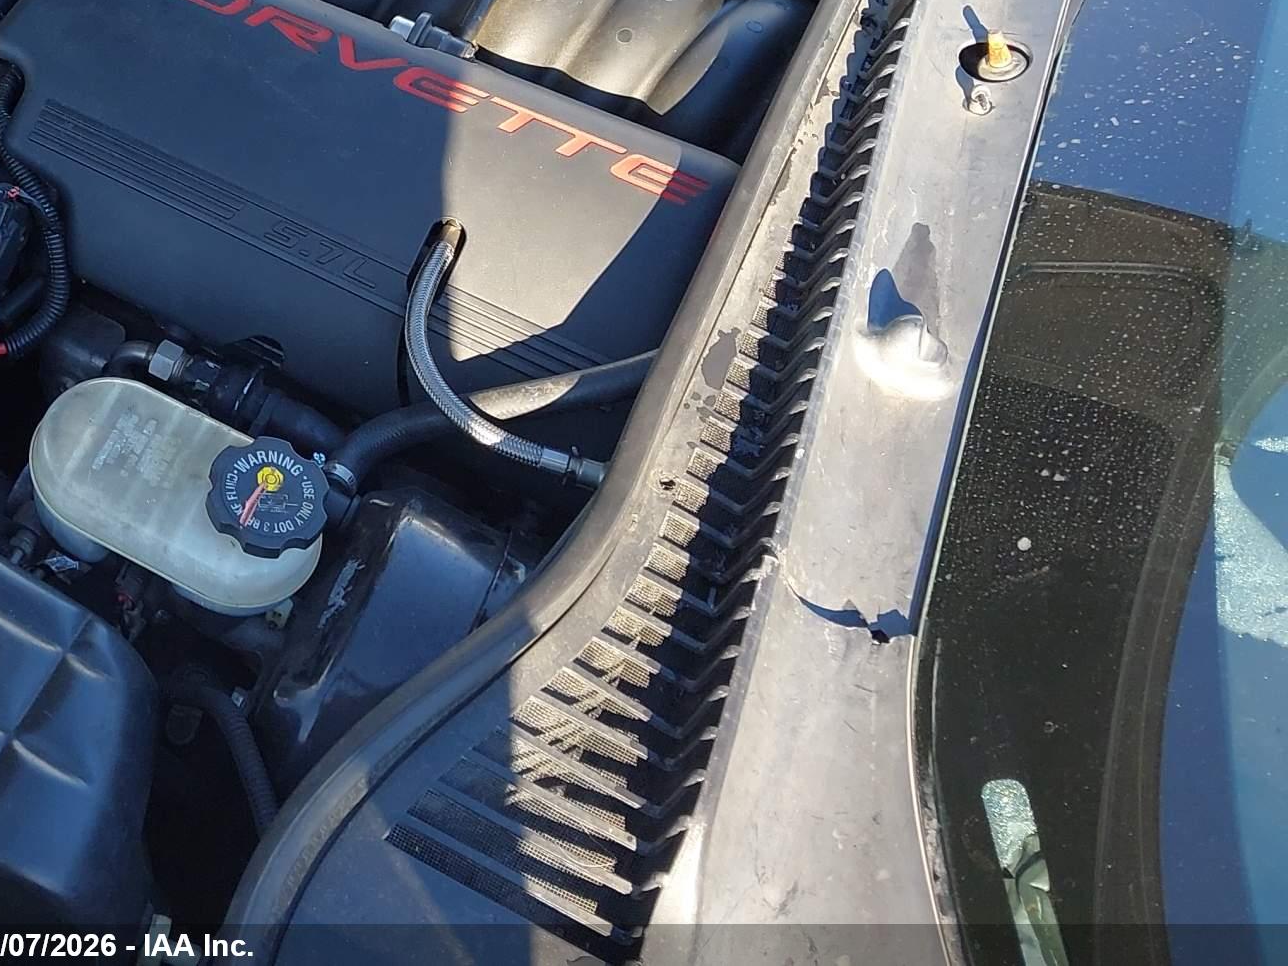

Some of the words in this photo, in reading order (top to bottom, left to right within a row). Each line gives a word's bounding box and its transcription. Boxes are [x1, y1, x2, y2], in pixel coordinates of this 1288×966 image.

[234, 450, 304, 476] WARNING
[225, 473, 239, 501] FLUID
[301, 480, 315, 501] USE
[296, 501, 314, 526] ONLY
[263, 522, 271, 532] 3
[273, 520, 295, 533] DOT
